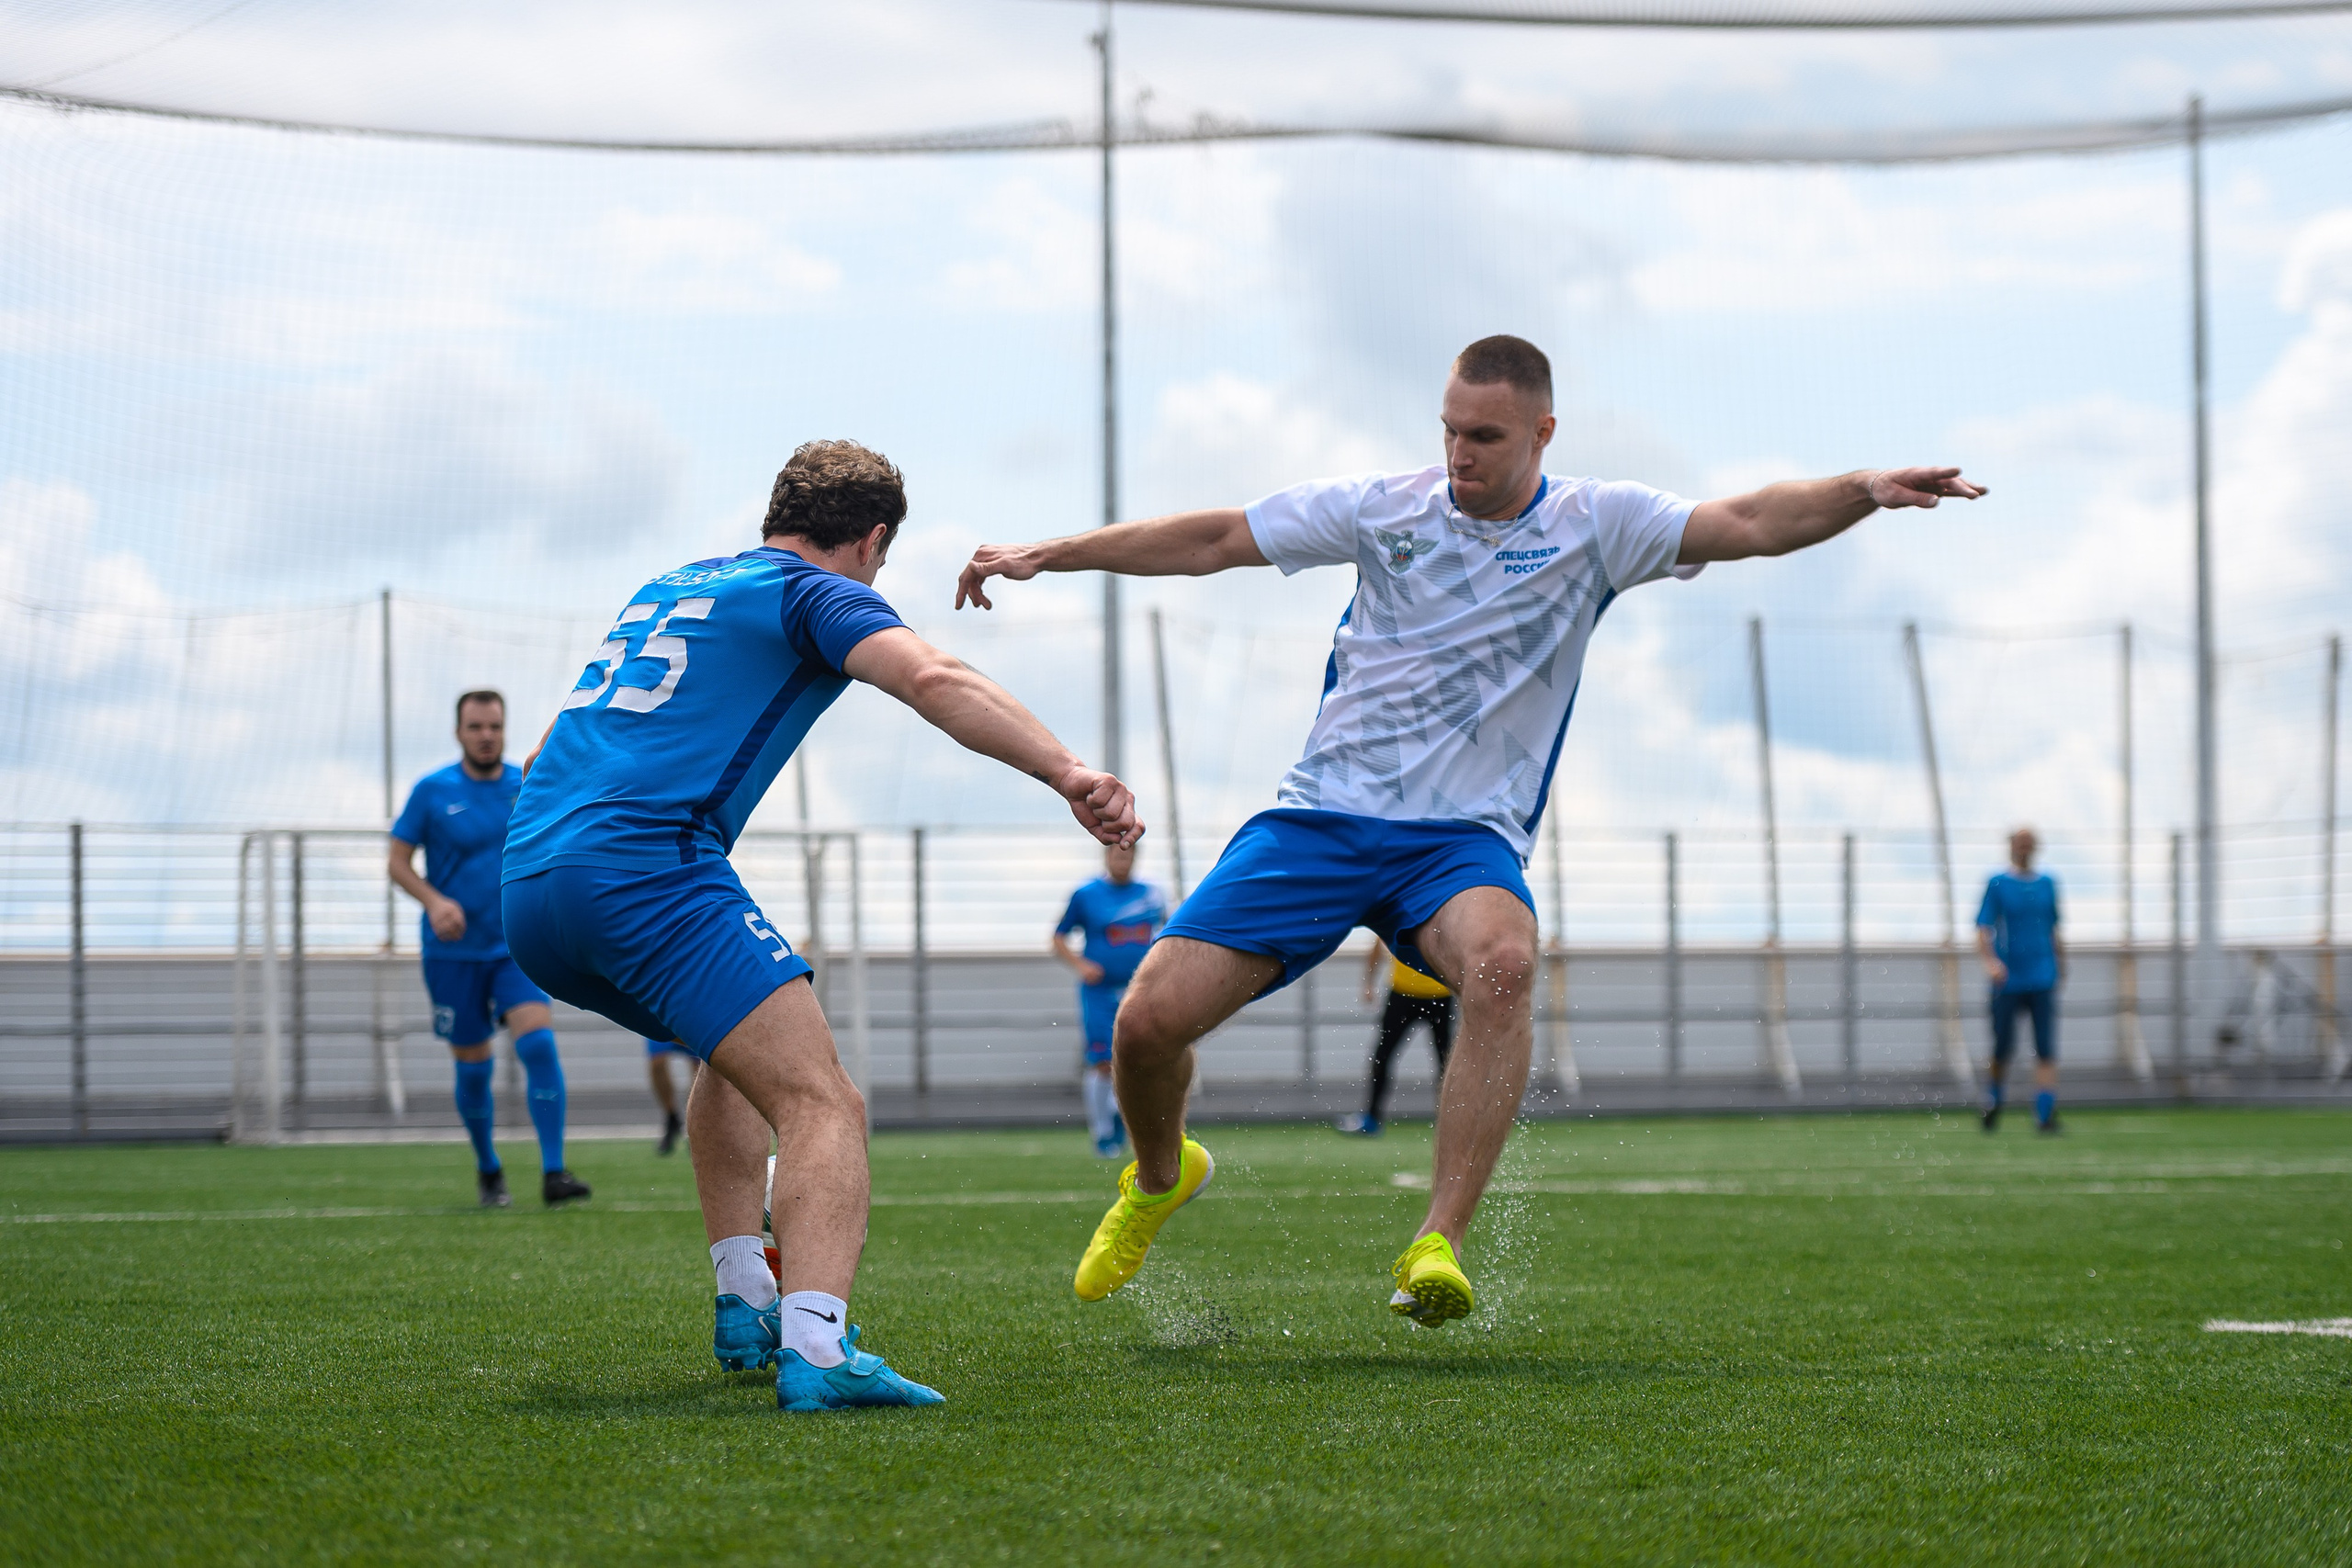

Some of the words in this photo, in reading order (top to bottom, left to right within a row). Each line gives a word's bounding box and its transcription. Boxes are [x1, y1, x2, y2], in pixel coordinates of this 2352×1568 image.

[1495, 546, 1561, 561] СПЕЦСВЯЗЬ
[1504, 559, 1550, 574] РОССИ
[560, 597, 717, 714] 55
[742, 911, 791, 964] 5
